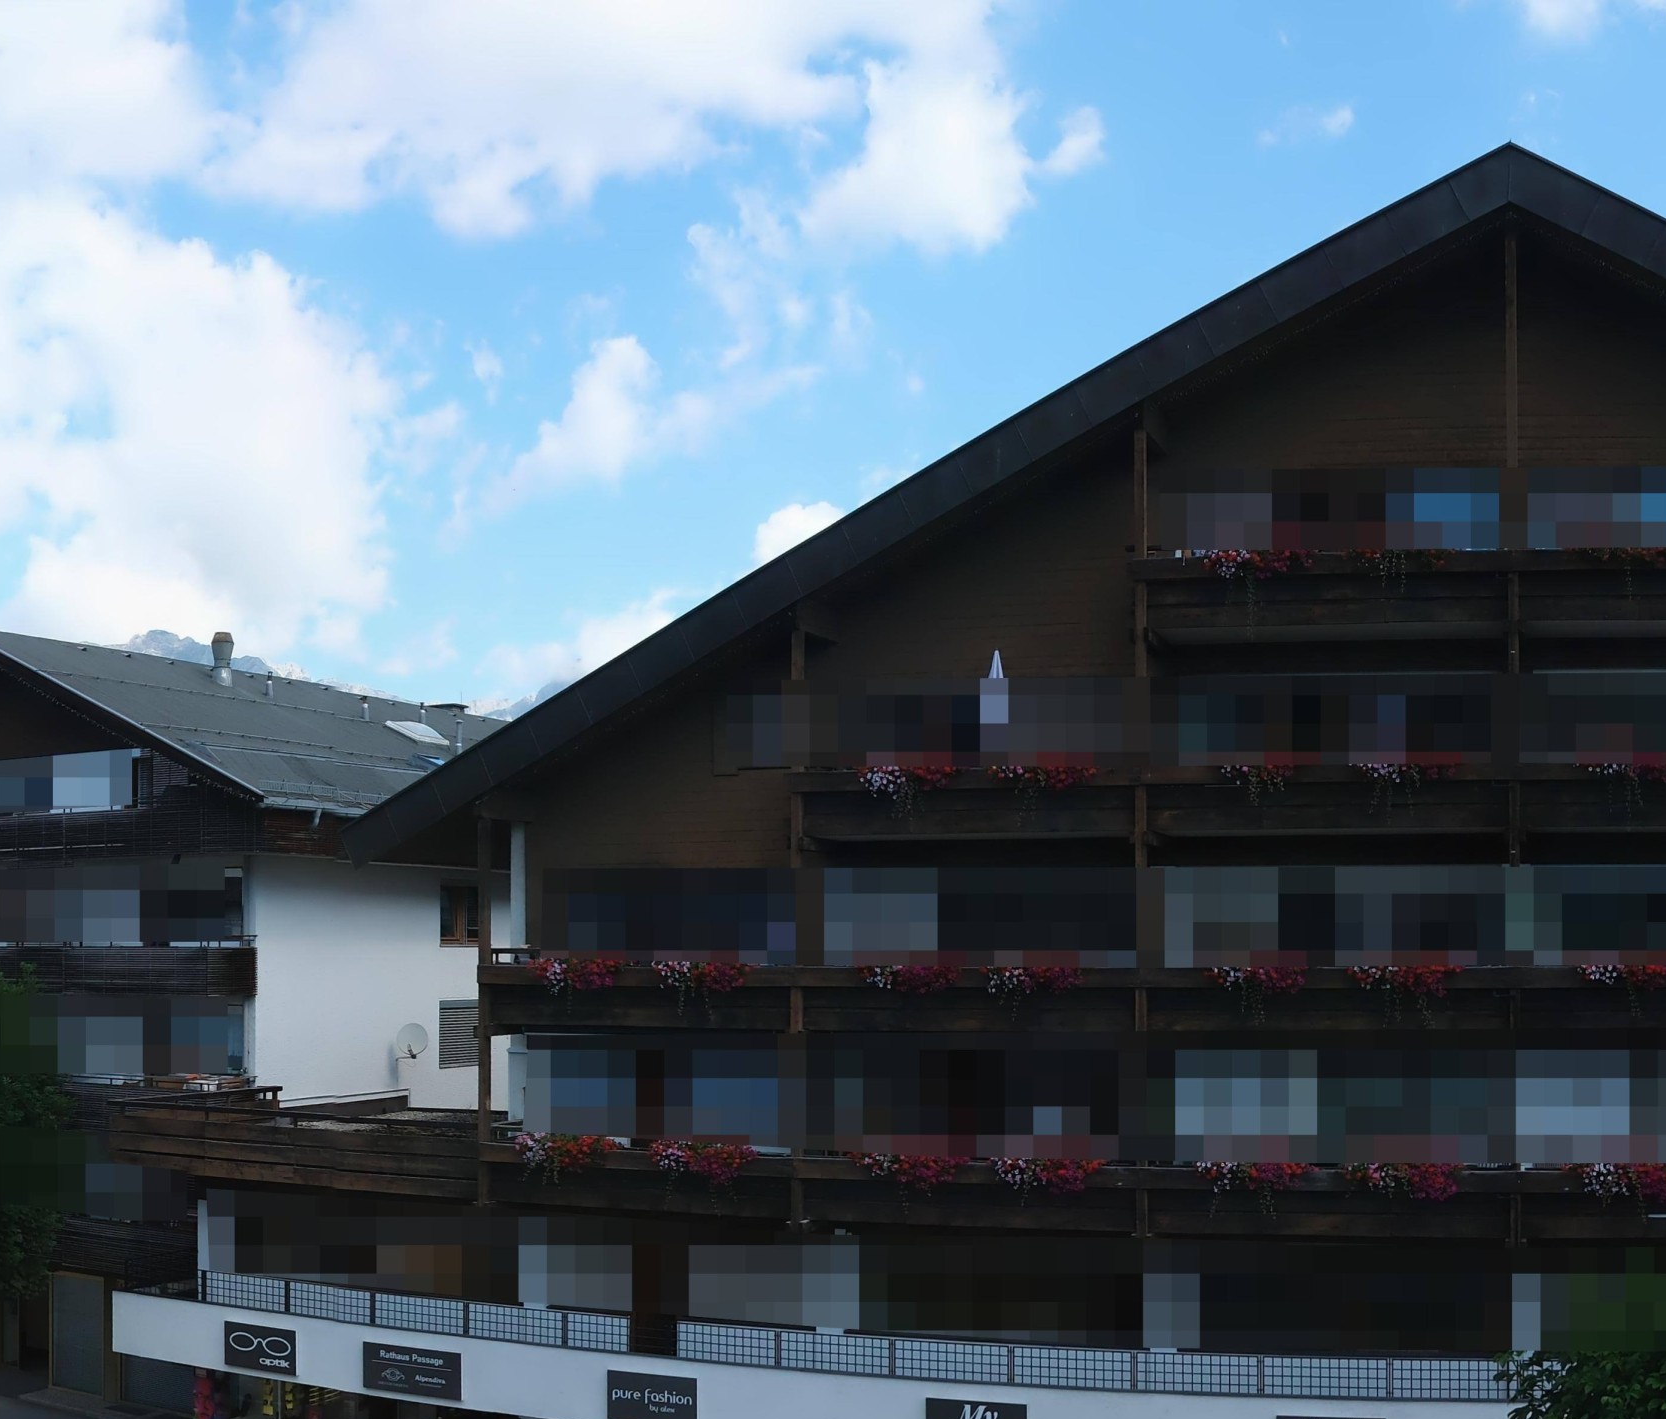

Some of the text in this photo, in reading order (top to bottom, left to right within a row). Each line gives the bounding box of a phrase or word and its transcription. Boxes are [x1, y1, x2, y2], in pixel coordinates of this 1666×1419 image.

[259, 1357, 290, 1368] optik
[380, 1350, 444, 1366] Rathaus Passage
[612, 1388, 692, 1405] pure fashion
[649, 1404, 658, 1413] by
